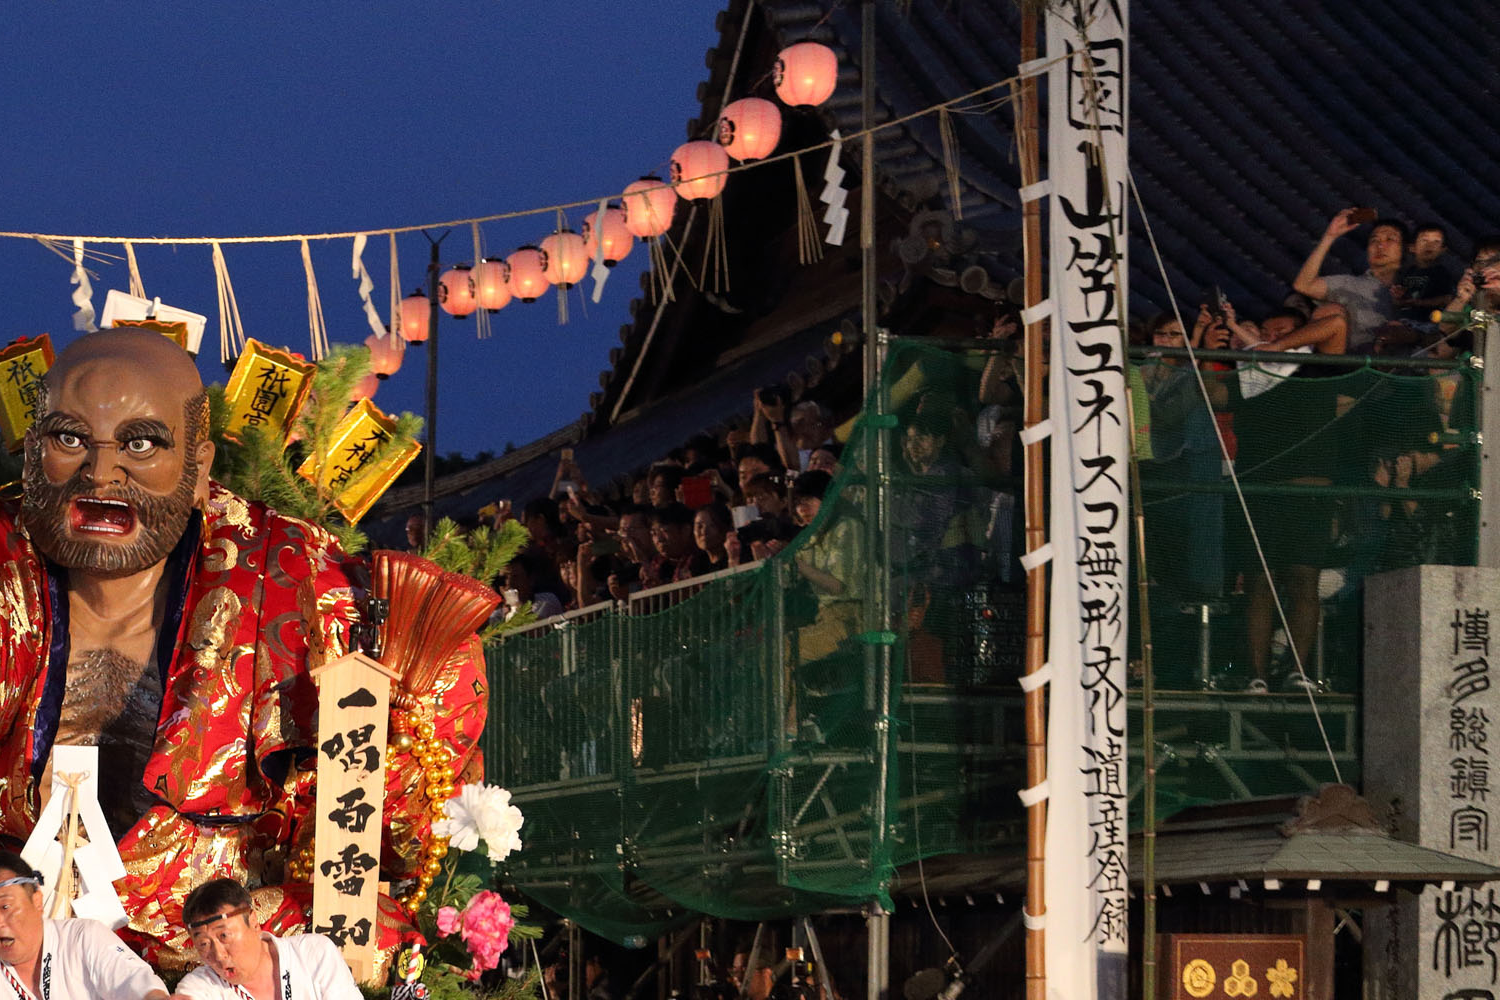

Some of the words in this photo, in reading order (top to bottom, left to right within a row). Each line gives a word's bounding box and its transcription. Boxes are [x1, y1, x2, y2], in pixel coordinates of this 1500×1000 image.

[1057, 0, 1128, 944] 園山笠ユネスコ無形文化遺産登録
